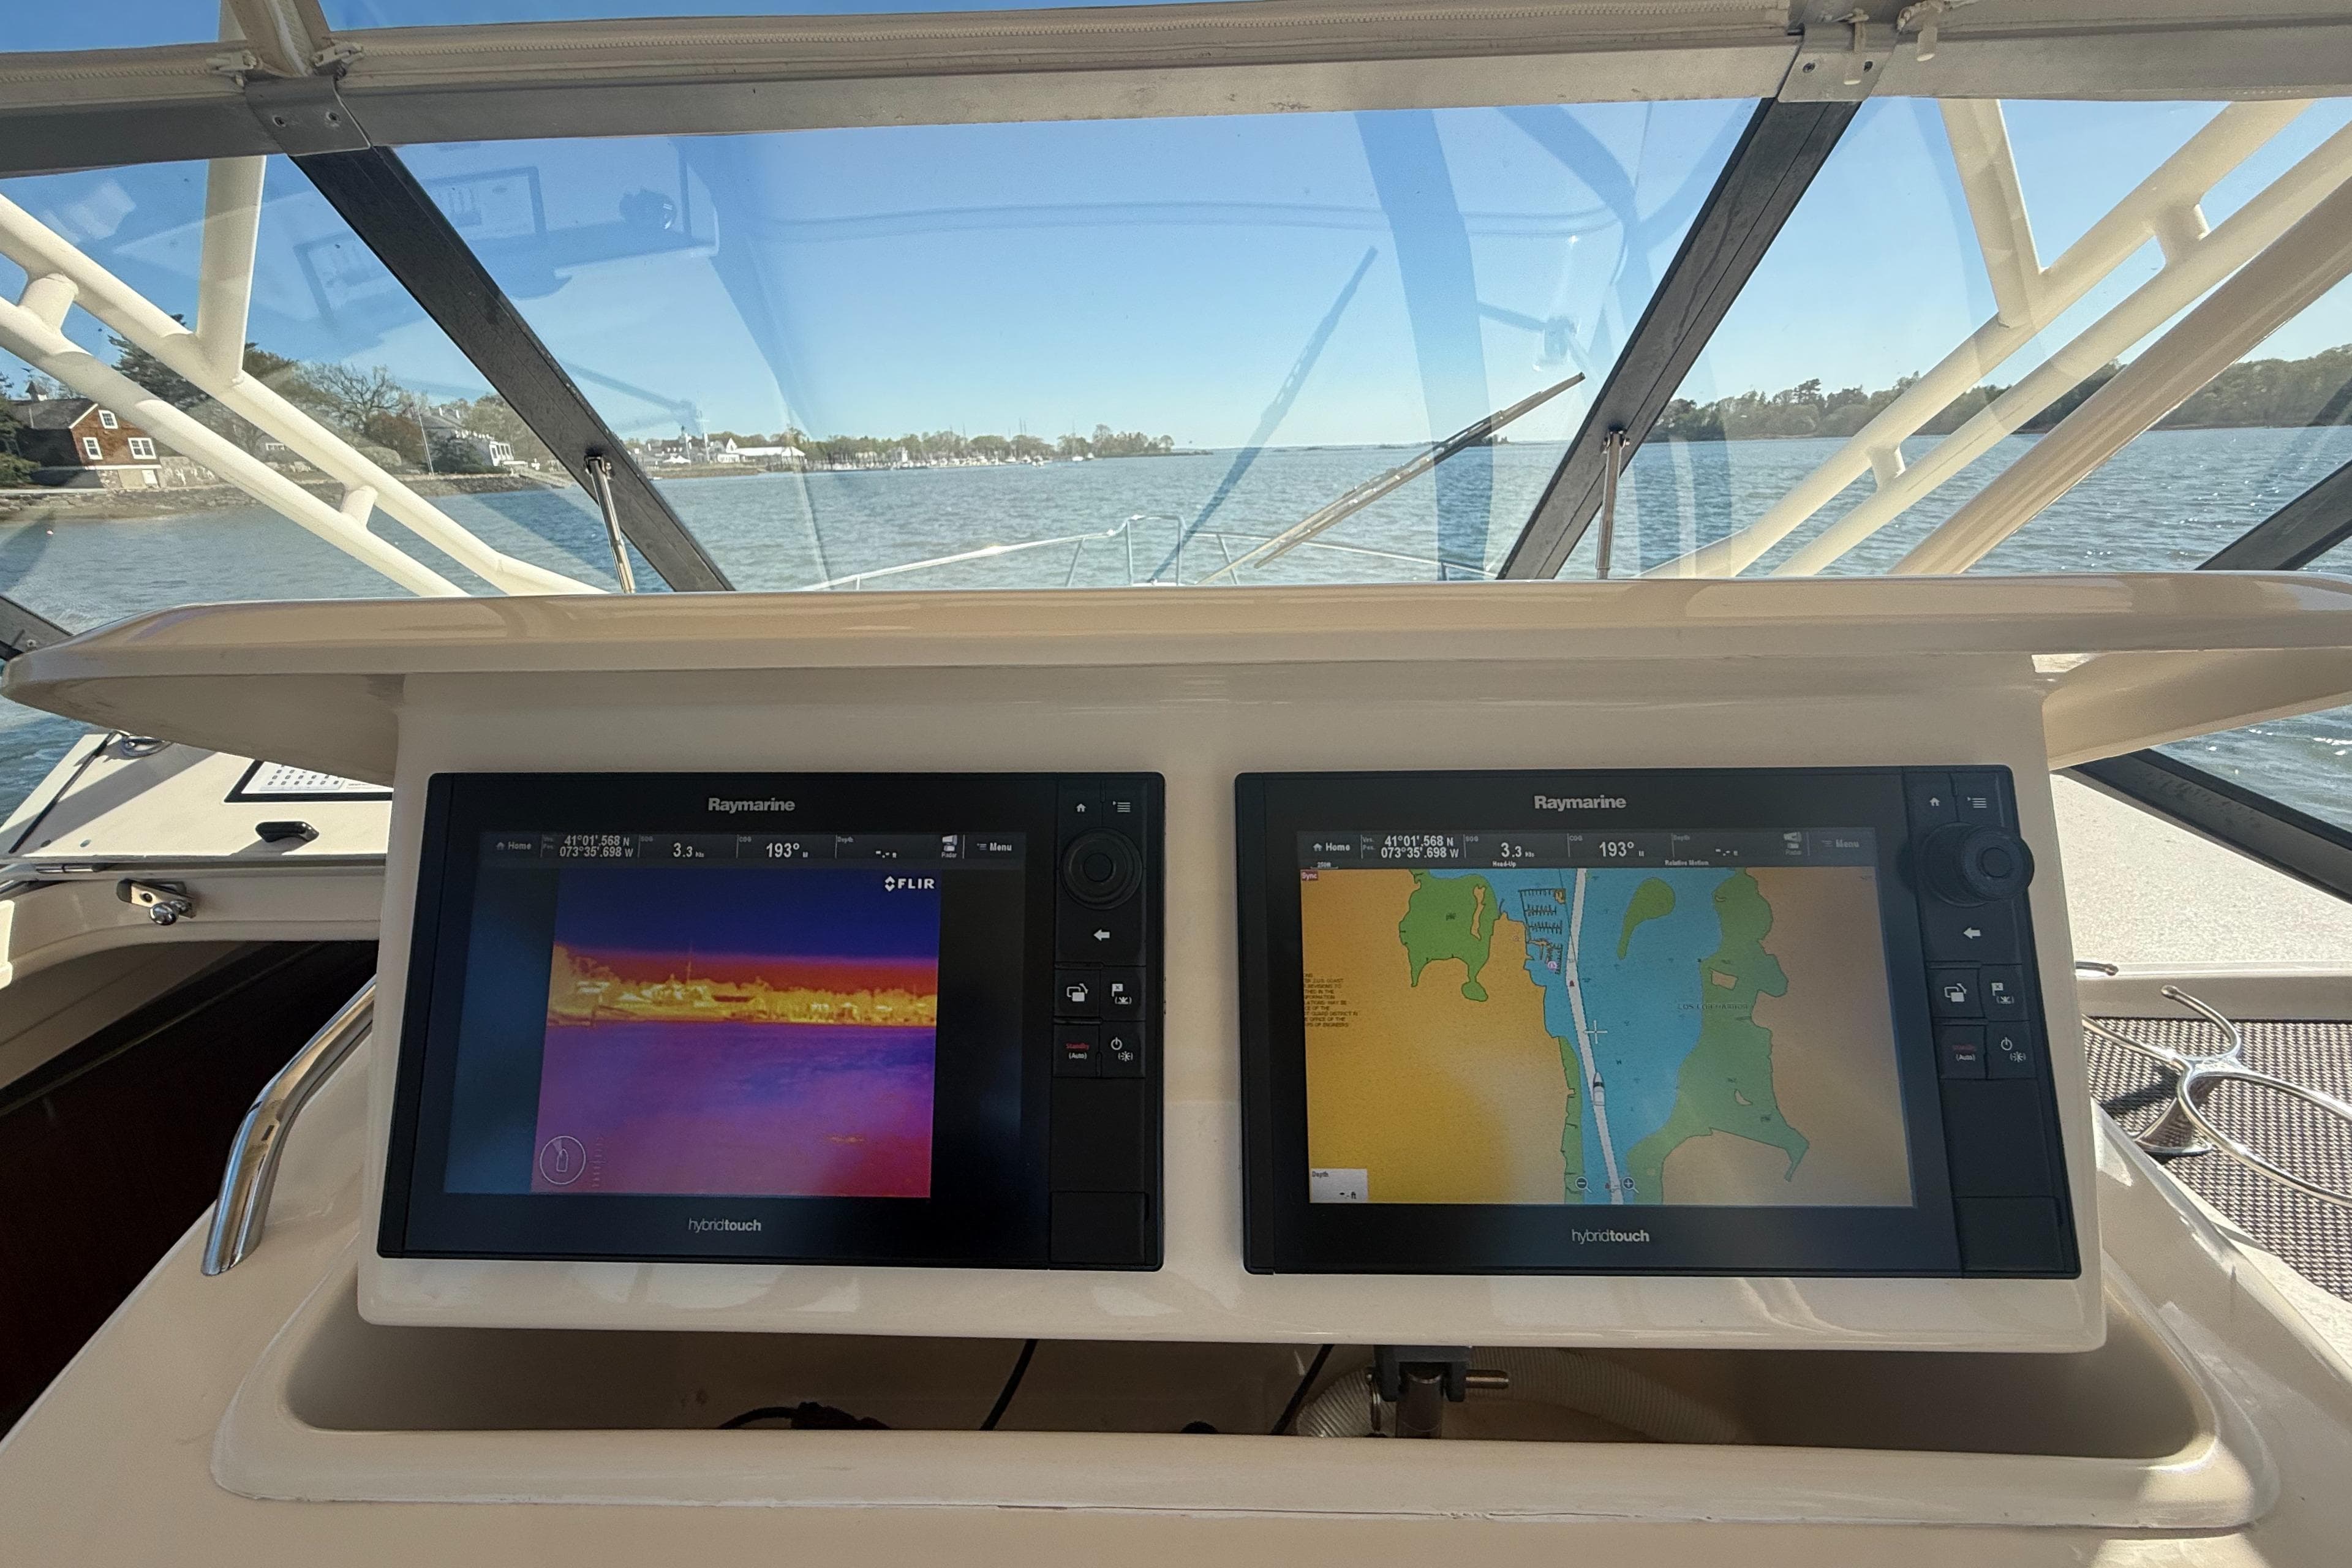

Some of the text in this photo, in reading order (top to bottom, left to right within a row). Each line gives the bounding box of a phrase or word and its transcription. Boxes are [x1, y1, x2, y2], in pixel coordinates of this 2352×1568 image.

[707, 797, 796, 814] Raymarine
[1534, 795, 1627, 812] Raymarine
[508, 842, 532, 850] Home
[622, 837, 630, 846] N
[989, 842, 1012, 851] Menu
[1325, 842, 1351, 851] Home
[1446, 837, 1453, 846] N
[1836, 839, 1860, 848] Menu
[625, 847, 634, 857] W
[673, 843, 693, 858] 3.3
[766, 843, 800, 858] 193°
[1449, 849, 1460, 858] W
[1501, 842, 1522, 858] 3.3
[1599, 841, 1635, 858] 193°
[1302, 872, 1317, 880] Sync
[898, 878, 935, 889] FLIR
[688, 1218, 761, 1233] hybridtouch
[1572, 1229, 1649, 1245] hybridtouch
